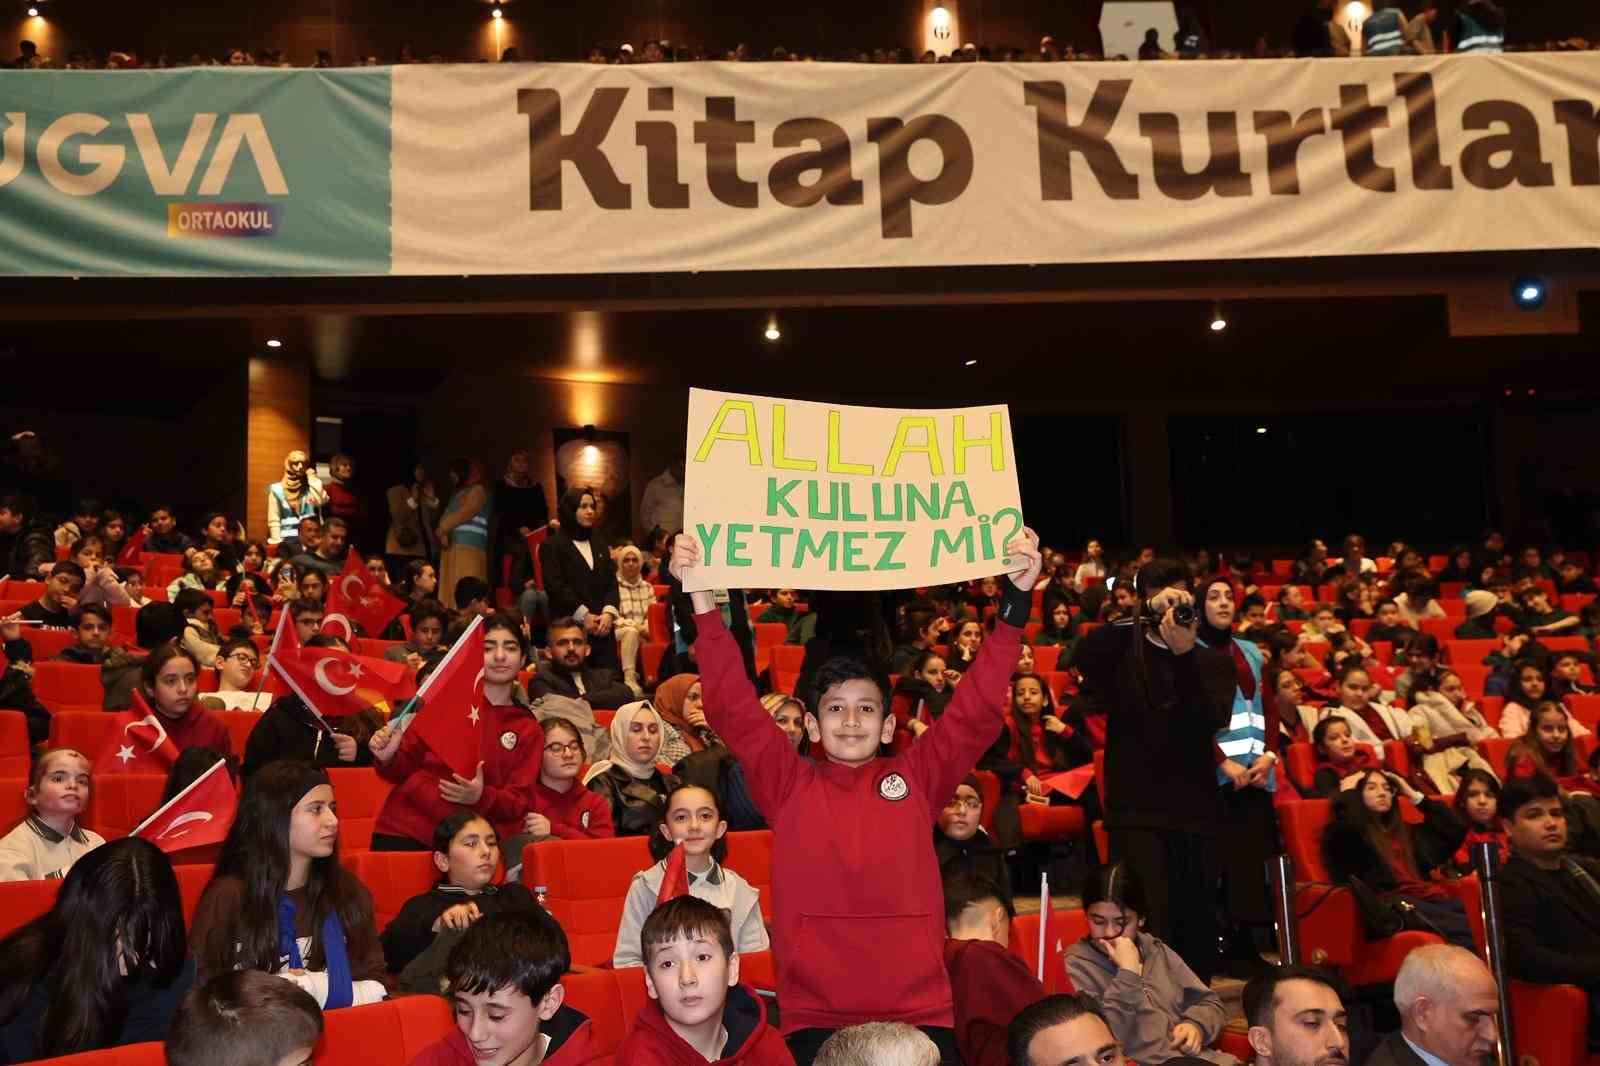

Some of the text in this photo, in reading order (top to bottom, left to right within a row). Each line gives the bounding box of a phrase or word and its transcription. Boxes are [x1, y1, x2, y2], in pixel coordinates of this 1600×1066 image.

[517, 87, 974, 239] Kitap
[178, 210, 273, 230] ORTAOKUL
[693, 399, 1005, 477] ALLAH
[766, 477, 975, 521] KULUNA
[696, 523, 906, 571] YETMEZ
